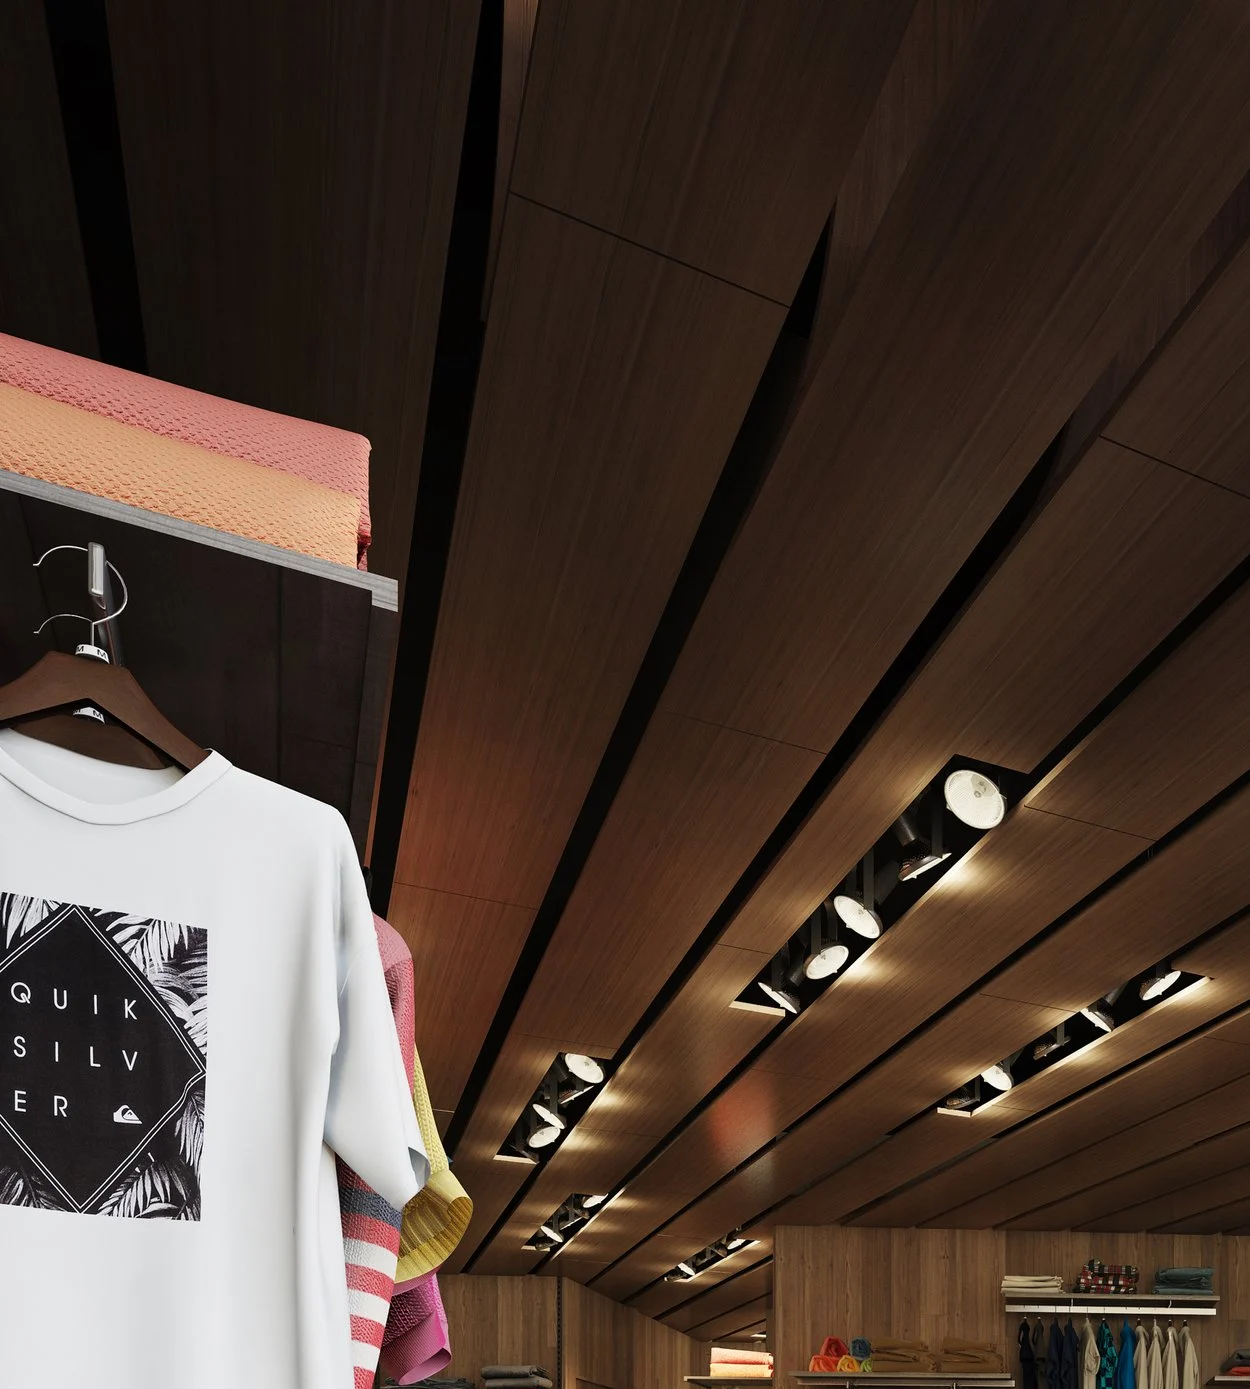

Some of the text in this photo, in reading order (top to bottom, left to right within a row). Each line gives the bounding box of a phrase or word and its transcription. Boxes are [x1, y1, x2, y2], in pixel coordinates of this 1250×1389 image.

[96, 649, 107, 659] M
[92, 710, 103, 719] M
[10, 981, 138, 1020] QUIK
[13, 1035, 138, 1071] SILV
[14, 1090, 68, 1118] ER
